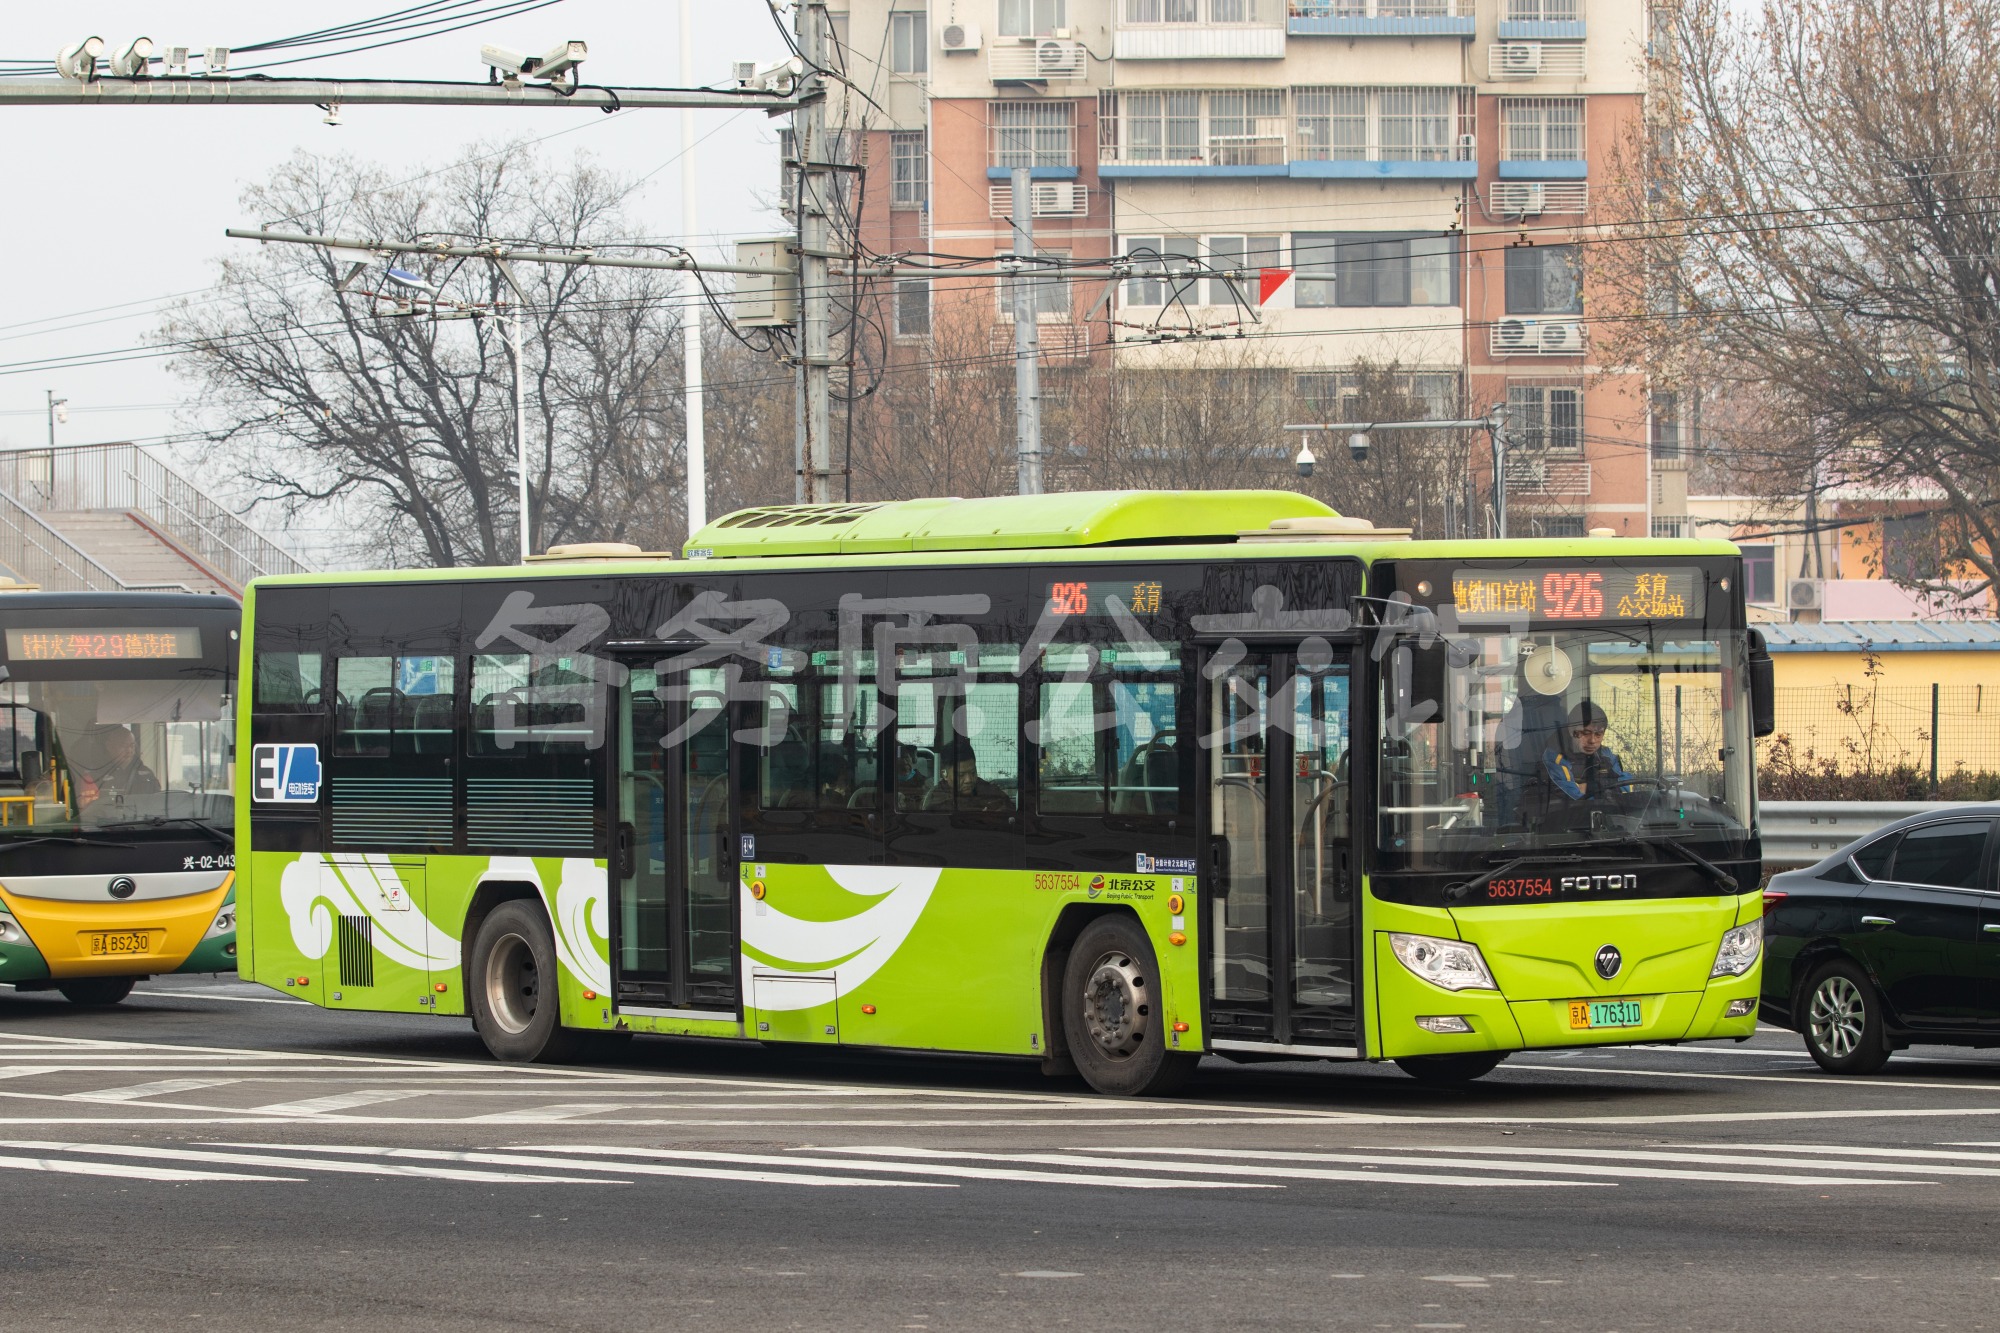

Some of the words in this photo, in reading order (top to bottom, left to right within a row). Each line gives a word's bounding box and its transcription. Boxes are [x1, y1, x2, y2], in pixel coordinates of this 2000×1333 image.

[1634, 573, 1668, 595] 采育
[1052, 582, 1088, 614] 926
[1131, 581, 1162, 613] 采育
[1542, 572, 1604, 618] 926
[1617, 594, 1685, 618] 公交场站
[254, 746, 302, 800] EV
[288, 782, 315, 796] 电动汽车
[1034, 873, 1080, 891] 5637554
[1108, 879, 1156, 891] 北京公交
[1488, 878, 1553, 898] 5637554
[1560, 874, 1637, 891] FOTON
[1106, 892, 1121, 901] Beijing
